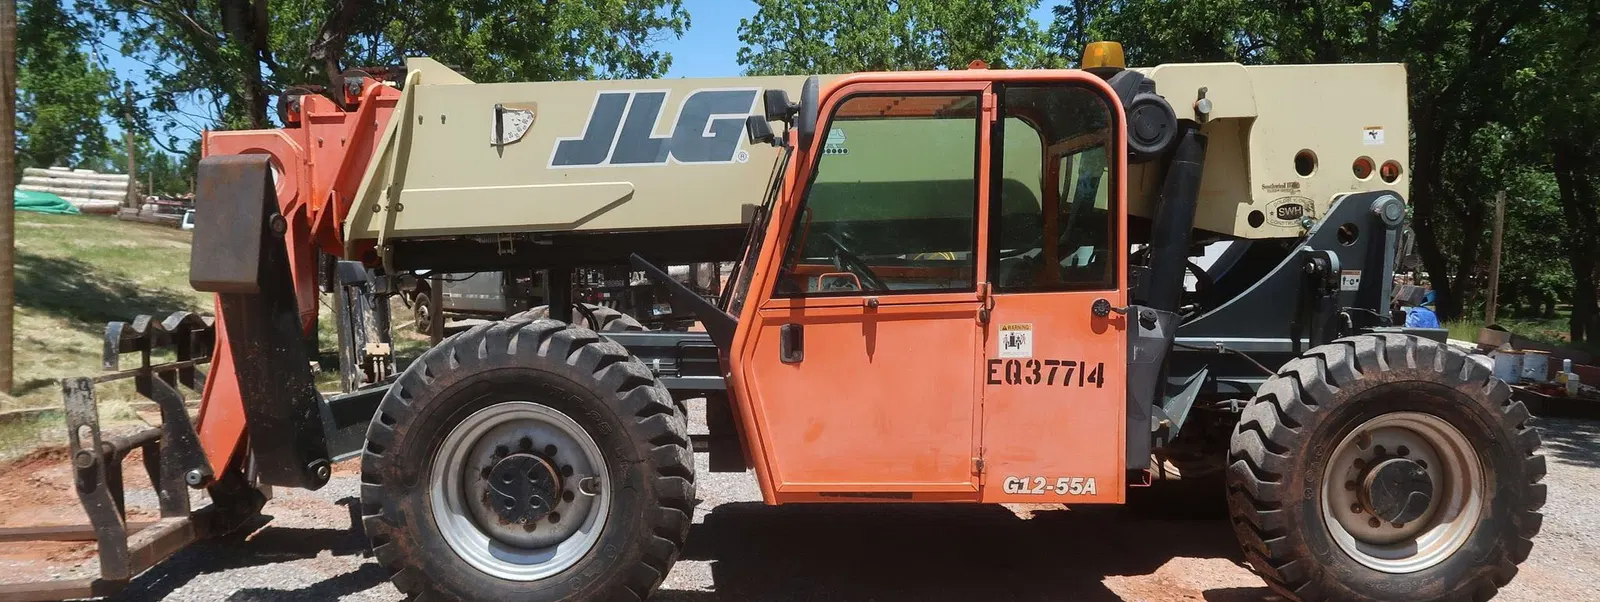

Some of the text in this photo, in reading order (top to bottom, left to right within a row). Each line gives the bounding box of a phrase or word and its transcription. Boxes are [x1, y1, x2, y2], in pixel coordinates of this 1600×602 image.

[547, 88, 761, 169] JLG
[1278, 206, 1302, 217] SWH
[986, 359, 1105, 389] EQ37714
[1003, 476, 1097, 496] G12-55A
